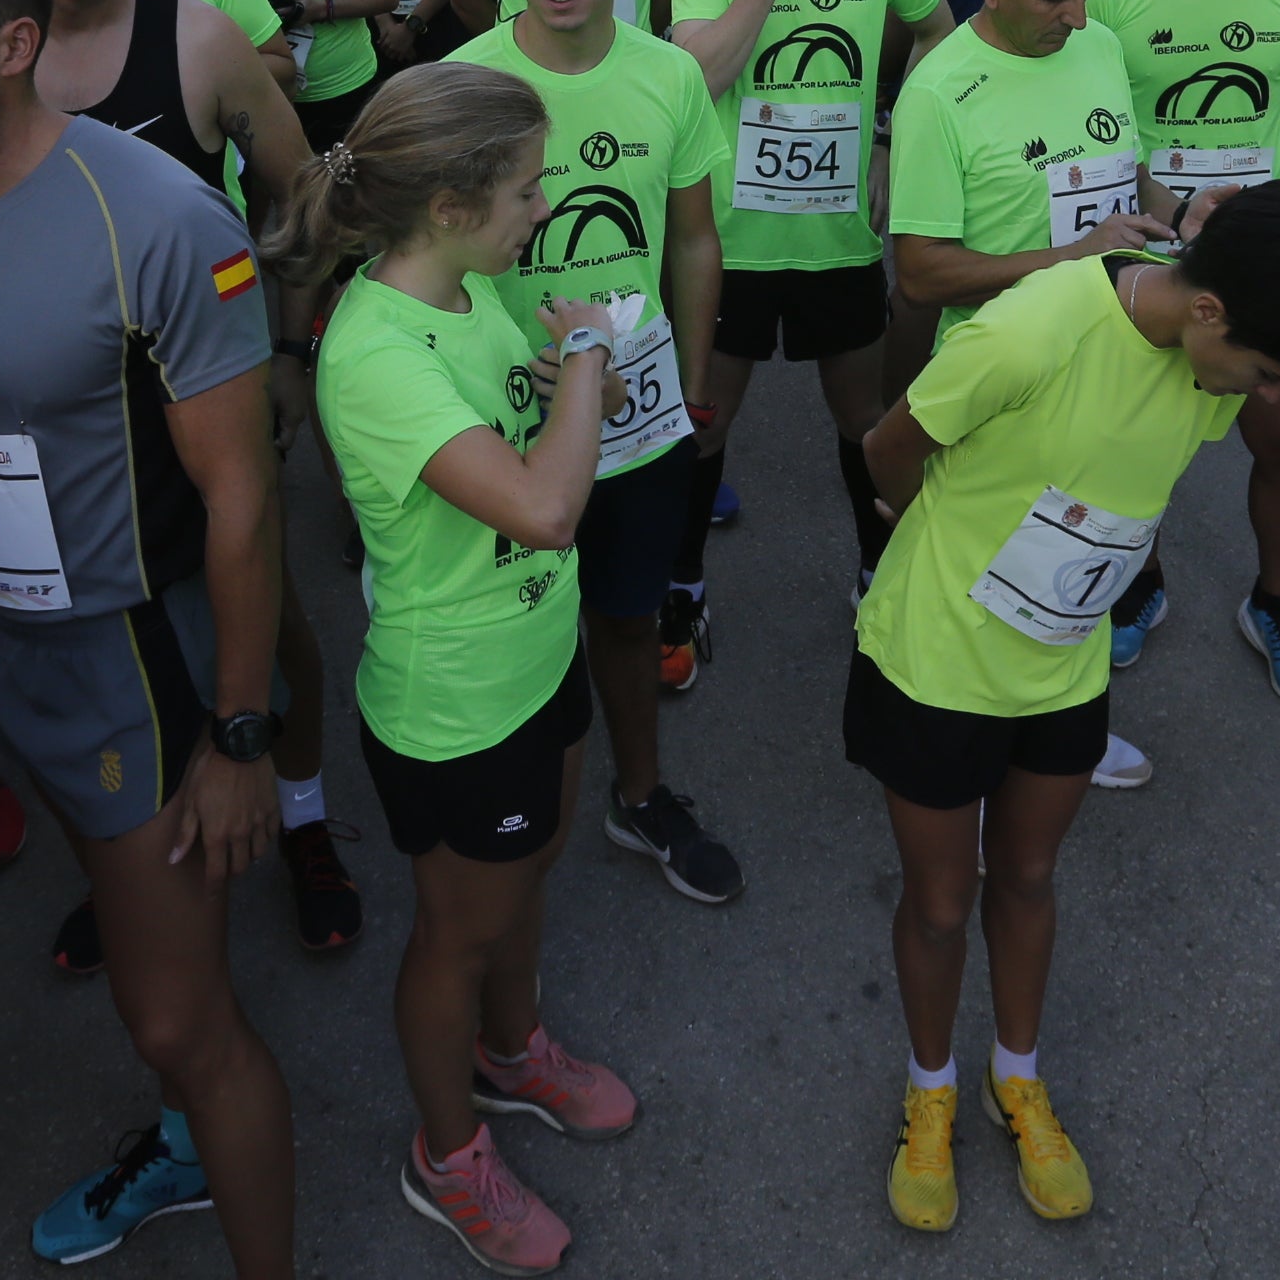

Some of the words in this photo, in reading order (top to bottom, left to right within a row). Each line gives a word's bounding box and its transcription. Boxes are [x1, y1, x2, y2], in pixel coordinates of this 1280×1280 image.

[770, 4, 801, 13] DROLA
[1154, 43, 1210, 56] IBERDROLA
[754, 82, 765, 91] EN
[766, 82, 795, 91] FORMA
[817, 79, 828, 88] LA
[954, 80, 980, 105] luanvi
[1167, 119, 1198, 127] FORMA
[1222, 117, 1233, 125] LA
[621, 148, 650, 158] MUJER
[755, 137, 840, 182] 554
[1034, 144, 1086, 173] IBERDROLA
[520, 267, 533, 277] EN
[534, 265, 566, 275] FORMA
[591, 256, 605, 267] LA
[606, 248, 650, 264] IGUALDAD
[607, 362, 662, 429] 55
[495, 557, 512, 569] EN
